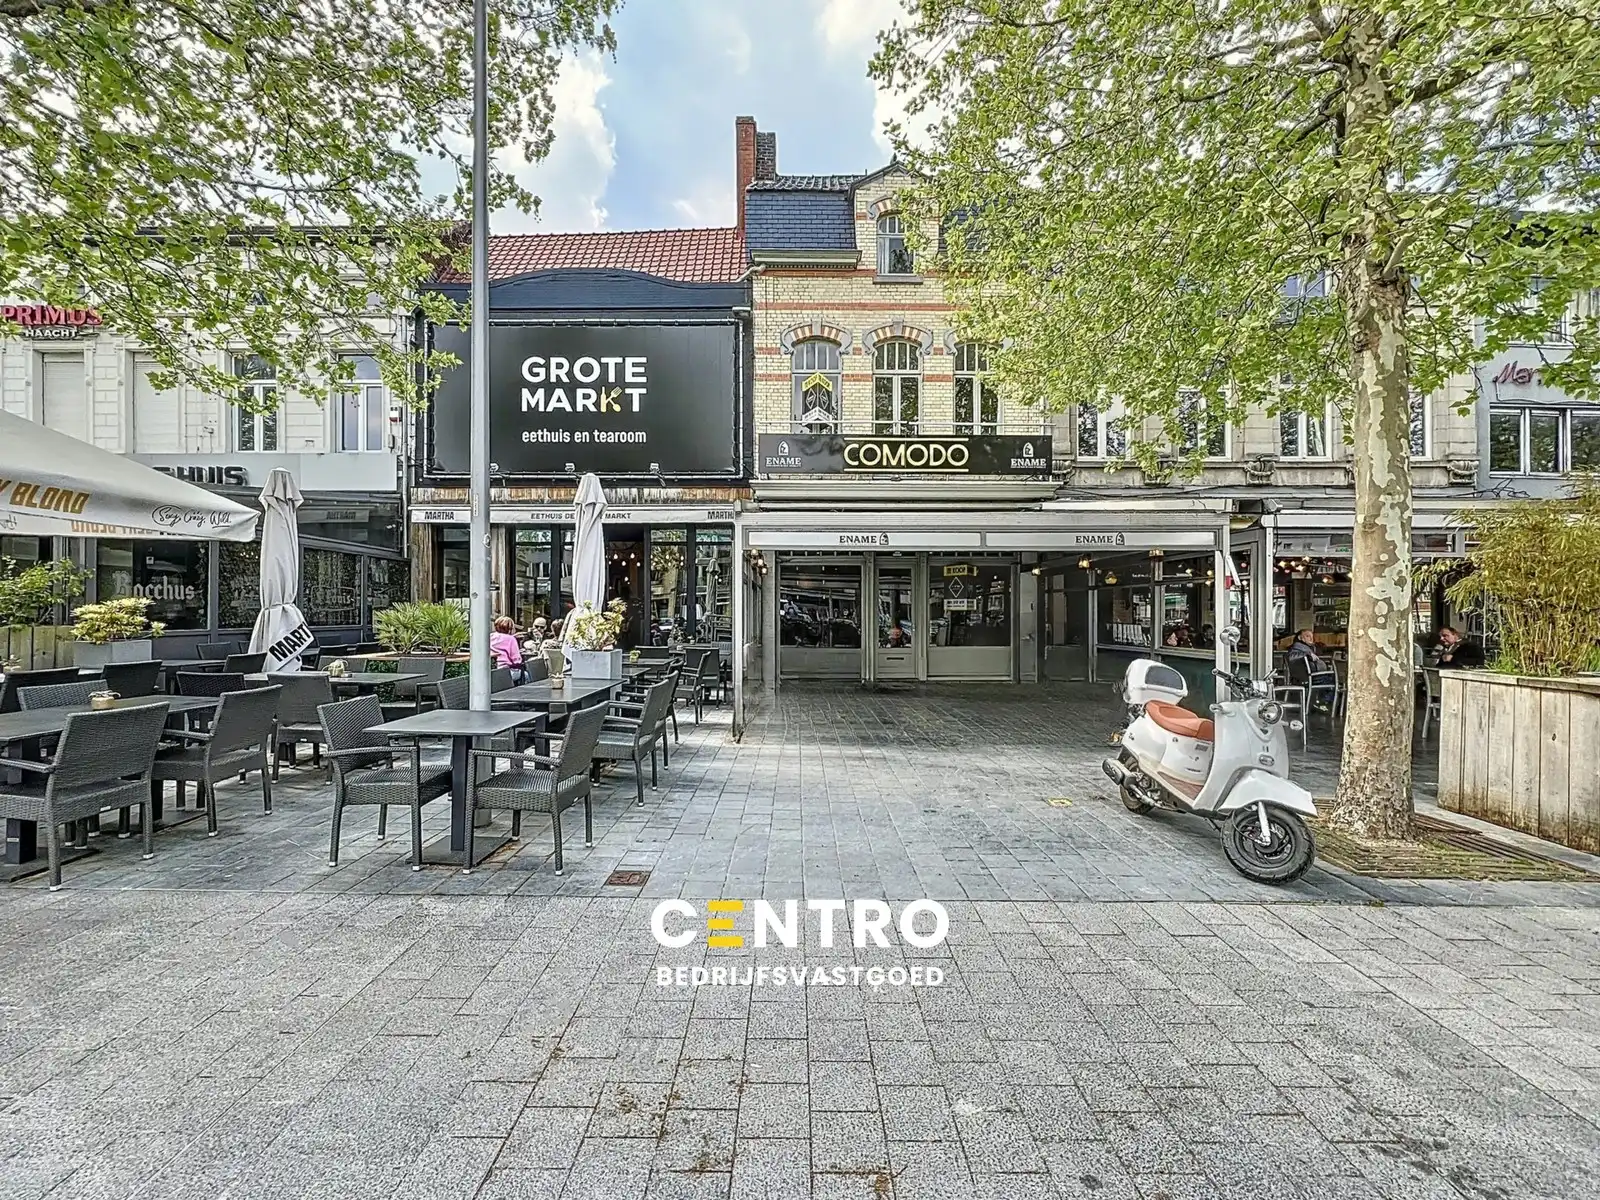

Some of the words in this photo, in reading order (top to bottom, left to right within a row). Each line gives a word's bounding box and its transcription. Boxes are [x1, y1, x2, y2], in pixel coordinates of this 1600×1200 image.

[0, 304, 103, 326] PRIMUS
[25, 329, 78, 337] HAACHT
[521, 356, 647, 383] GROTE
[521, 386, 647, 412] MARKT
[522, 428, 571, 443] eethuis
[574, 431, 590, 443] en
[593, 429, 647, 443] tearoom
[843, 443, 969, 467] COMODO
[766, 457, 802, 465] ENAME
[1010, 458, 1047, 467] ENAME
[424, 511, 455, 520] MARTHA
[530, 512, 563, 520] EETHUIS
[564, 512, 575, 520] DE
[604, 512, 632, 520] MARKT
[839, 535, 877, 544] ENAME
[1075, 535, 1114, 544] ENAME
[268, 620, 311, 662] MART
